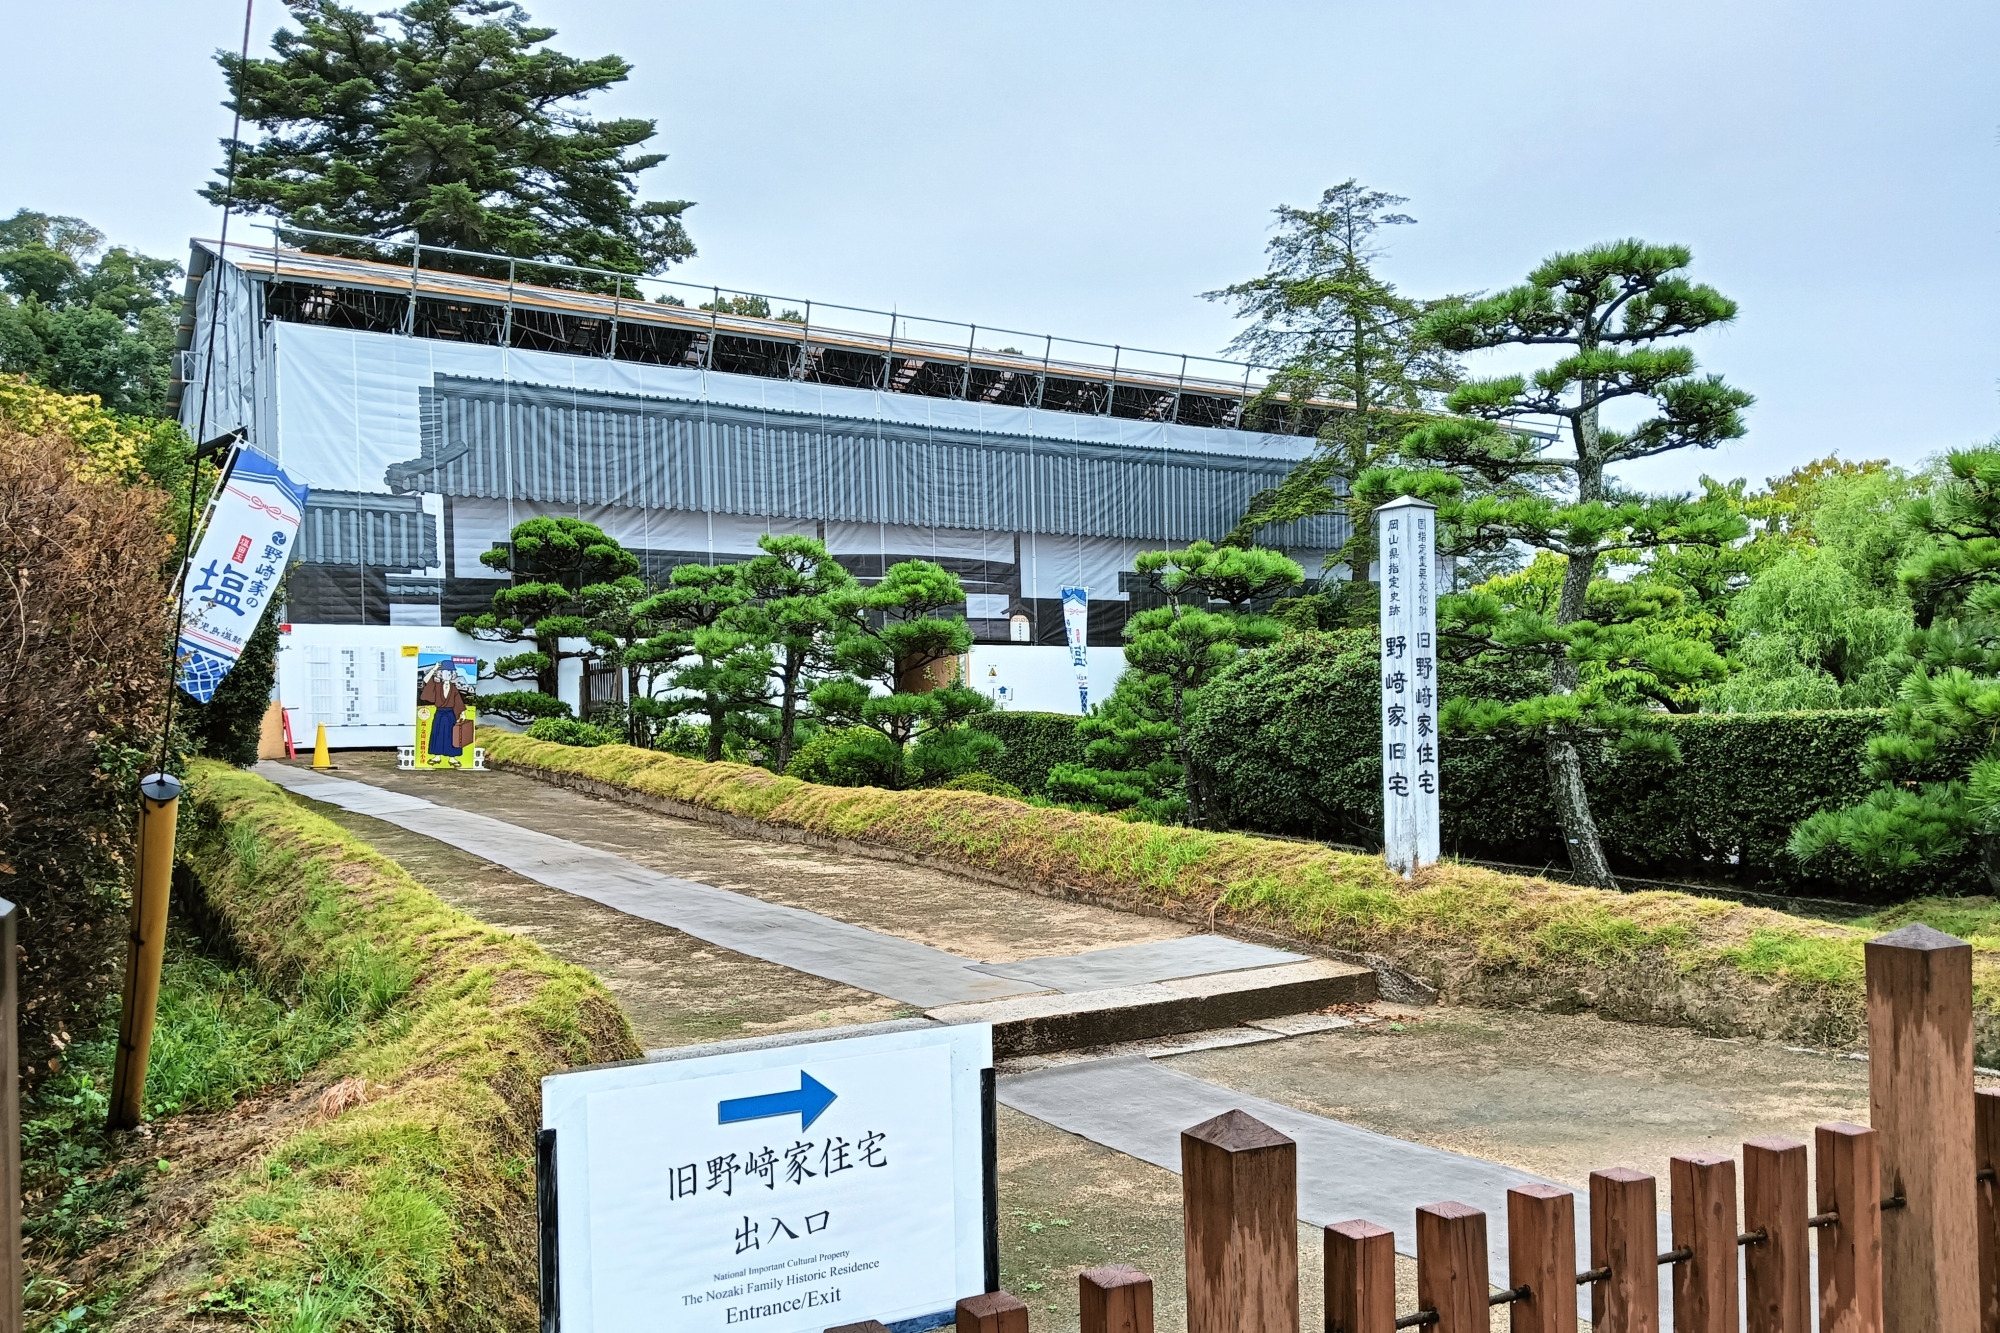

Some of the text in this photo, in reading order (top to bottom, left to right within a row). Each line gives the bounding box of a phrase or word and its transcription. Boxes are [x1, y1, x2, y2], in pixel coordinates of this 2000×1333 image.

[233, 537, 250, 562] 塩田王
[1387, 518, 1400, 617] 岡山県指定史跡
[1417, 518, 1428, 617] 国指定重要文化財
[192, 559, 249, 616] 塩
[735, 1210, 830, 1255] 出入口
[682, 1260, 880, 1306] The Nozaki Family Historic Residence
[713, 1250, 850, 1282] National Important Cultural Property
[726, 1287, 842, 1324] Entrance/Exit
